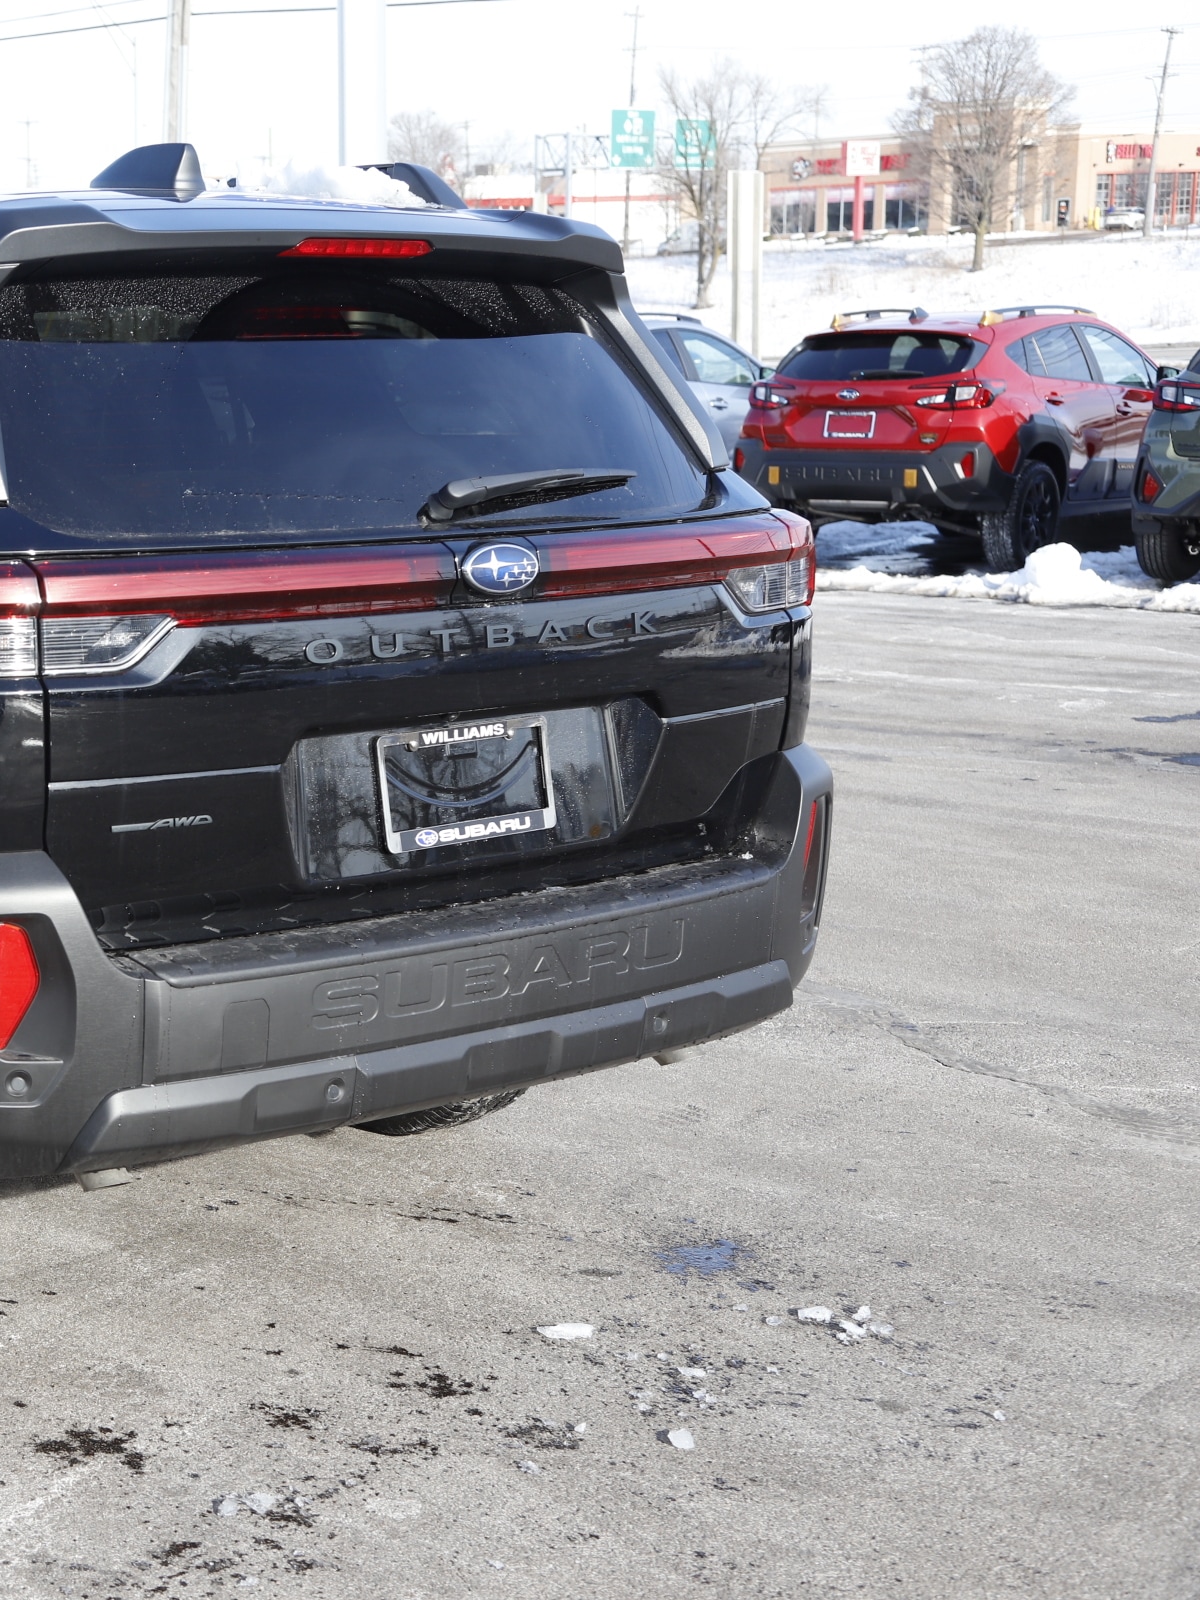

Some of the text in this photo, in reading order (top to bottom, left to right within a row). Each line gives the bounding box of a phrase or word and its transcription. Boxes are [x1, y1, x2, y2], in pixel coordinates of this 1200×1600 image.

[785, 466, 894, 481] SUBARU
[303, 611, 657, 664] OUTBACK
[421, 723, 505, 745] WILLIAMS
[150, 814, 213, 830] AWD
[438, 816, 531, 842] SUBARU
[311, 918, 685, 1030] SUBARU
